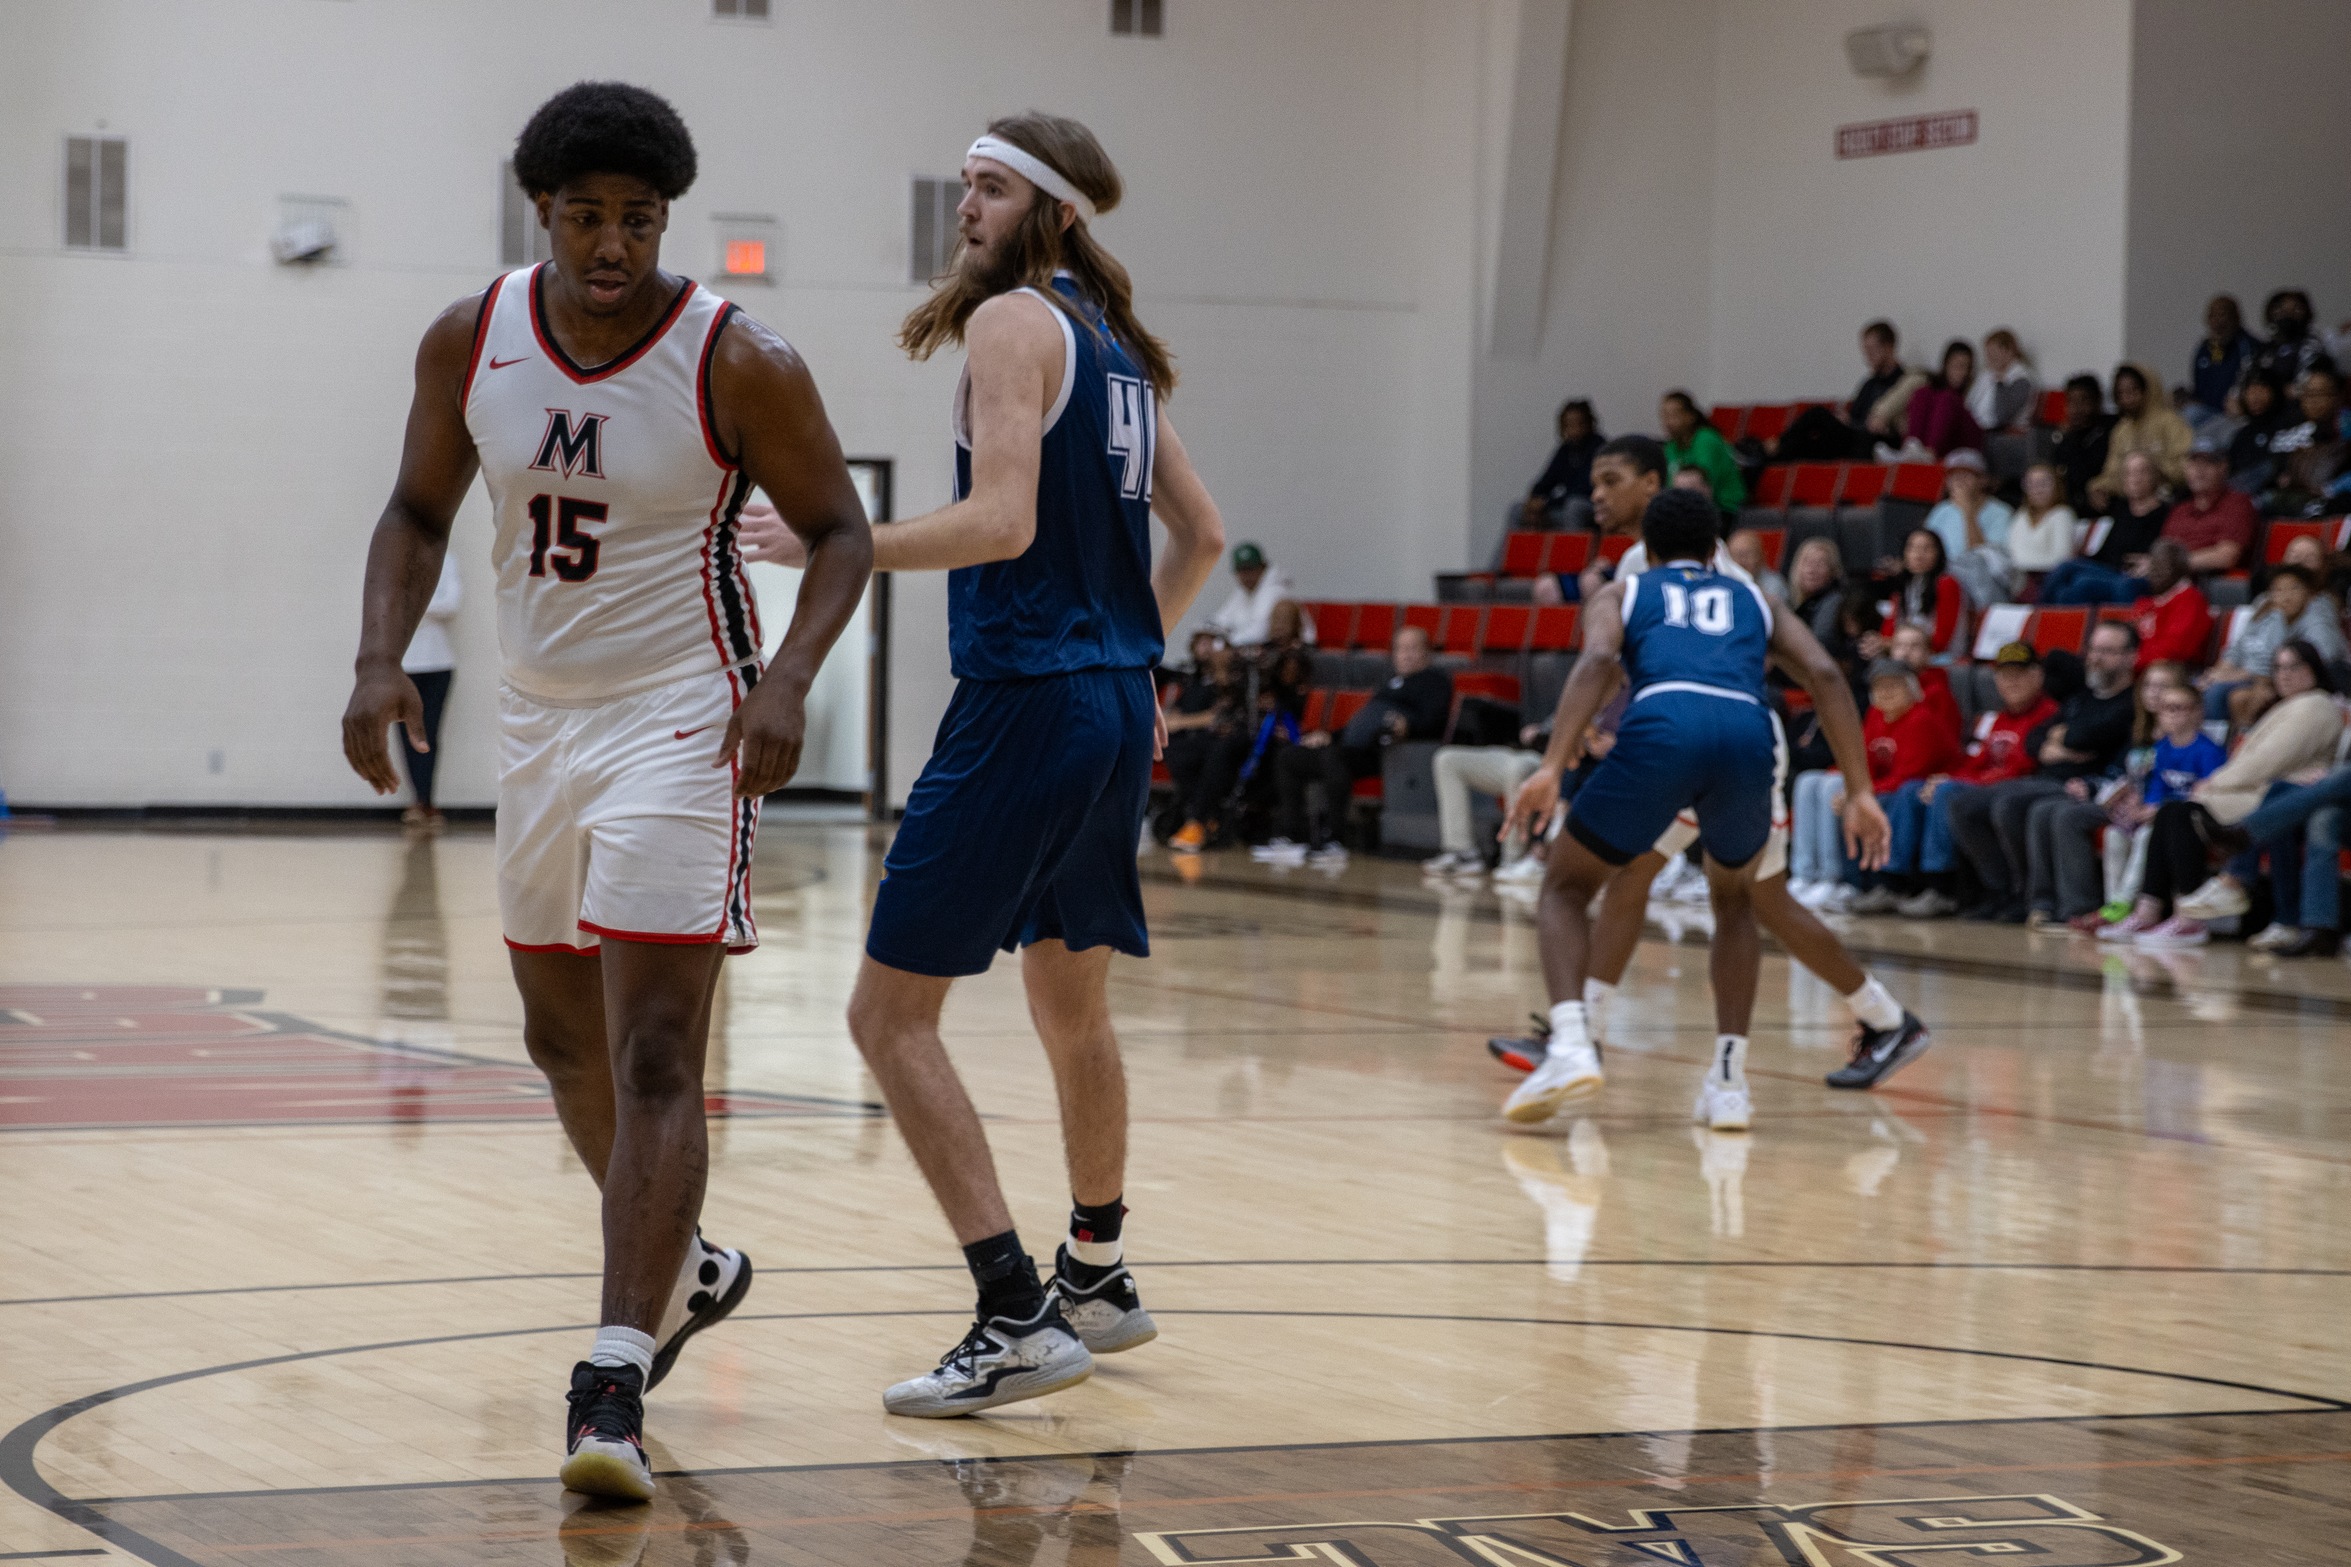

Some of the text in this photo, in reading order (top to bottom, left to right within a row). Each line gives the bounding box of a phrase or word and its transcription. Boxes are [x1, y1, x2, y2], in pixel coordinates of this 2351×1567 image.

[528, 408, 611, 481] M
[528, 493, 609, 582] 15
[1661, 582, 1734, 636] 10
